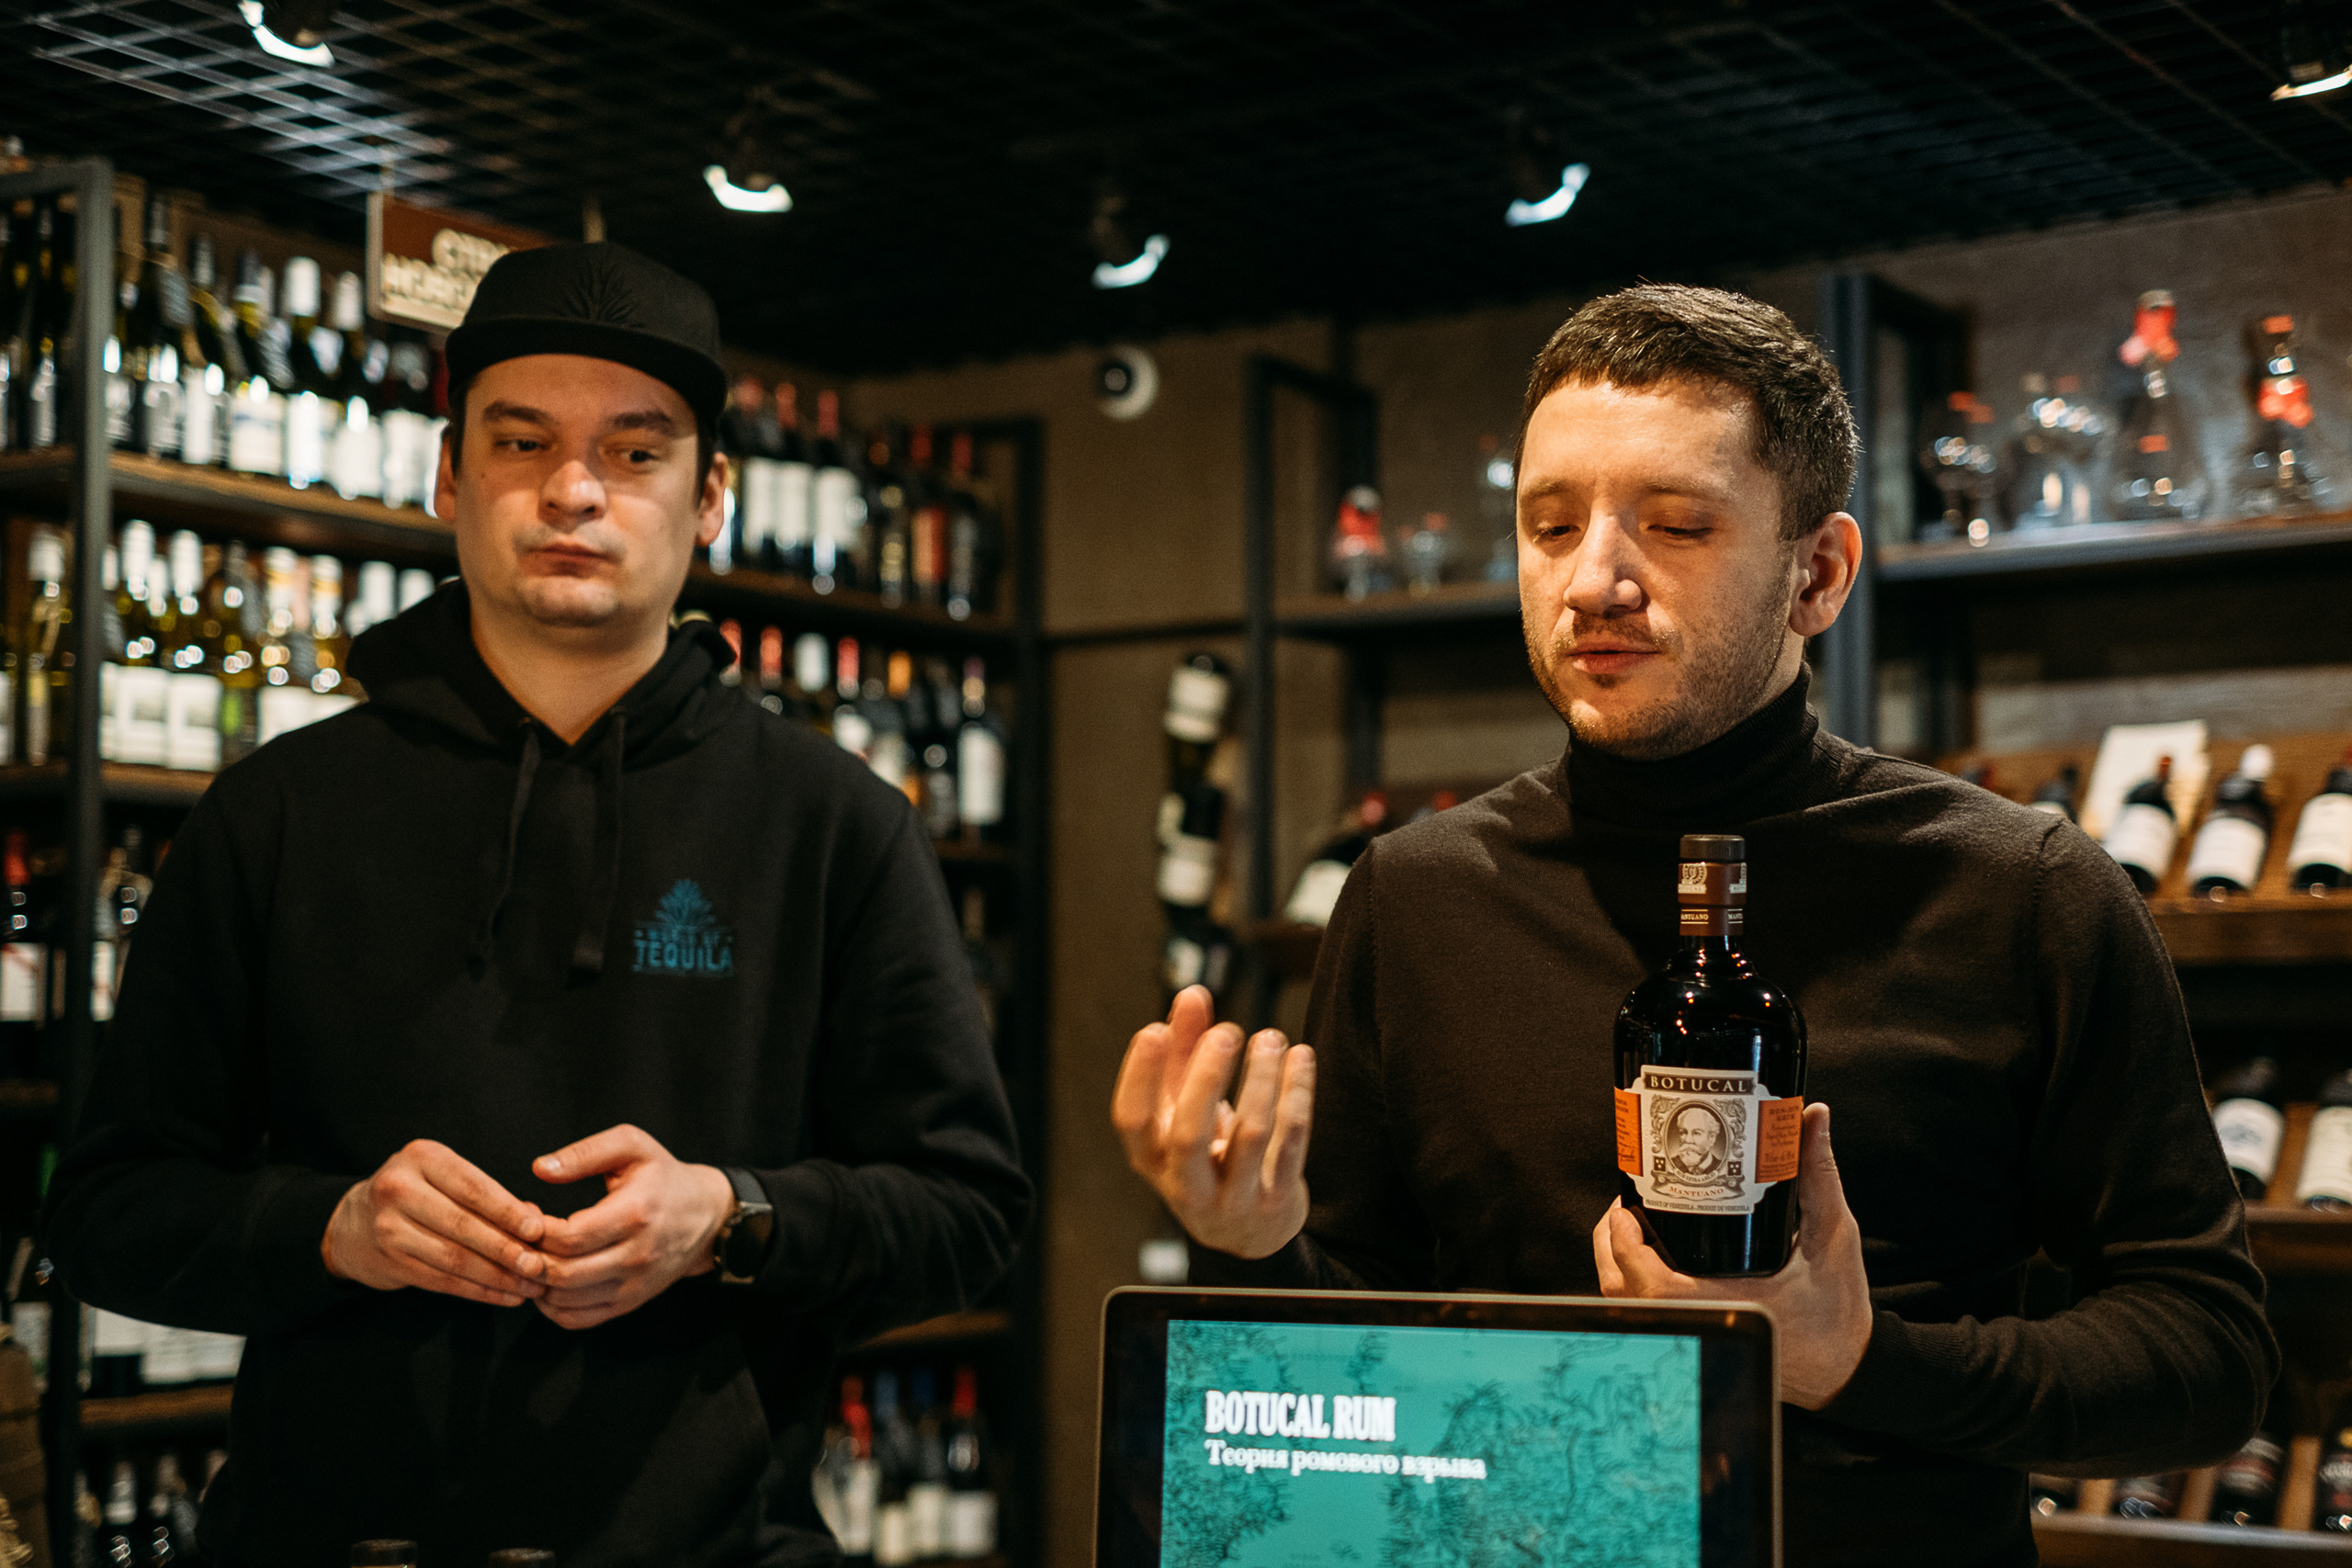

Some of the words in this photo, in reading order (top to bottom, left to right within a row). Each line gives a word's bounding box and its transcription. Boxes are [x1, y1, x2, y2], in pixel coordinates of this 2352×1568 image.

[633, 939, 733, 972] TEQUILA
[1650, 1075, 1747, 1093] BOTUCAL
[1668, 1185, 1724, 1197] MANTUANO
[1204, 1390, 1330, 1438] BOTUCAL
[1332, 1394, 1396, 1441] RUM
[1204, 1438, 1289, 1474] Теория
[1291, 1450, 1400, 1476] ромового
[1401, 1455, 1487, 1483] взрыва
